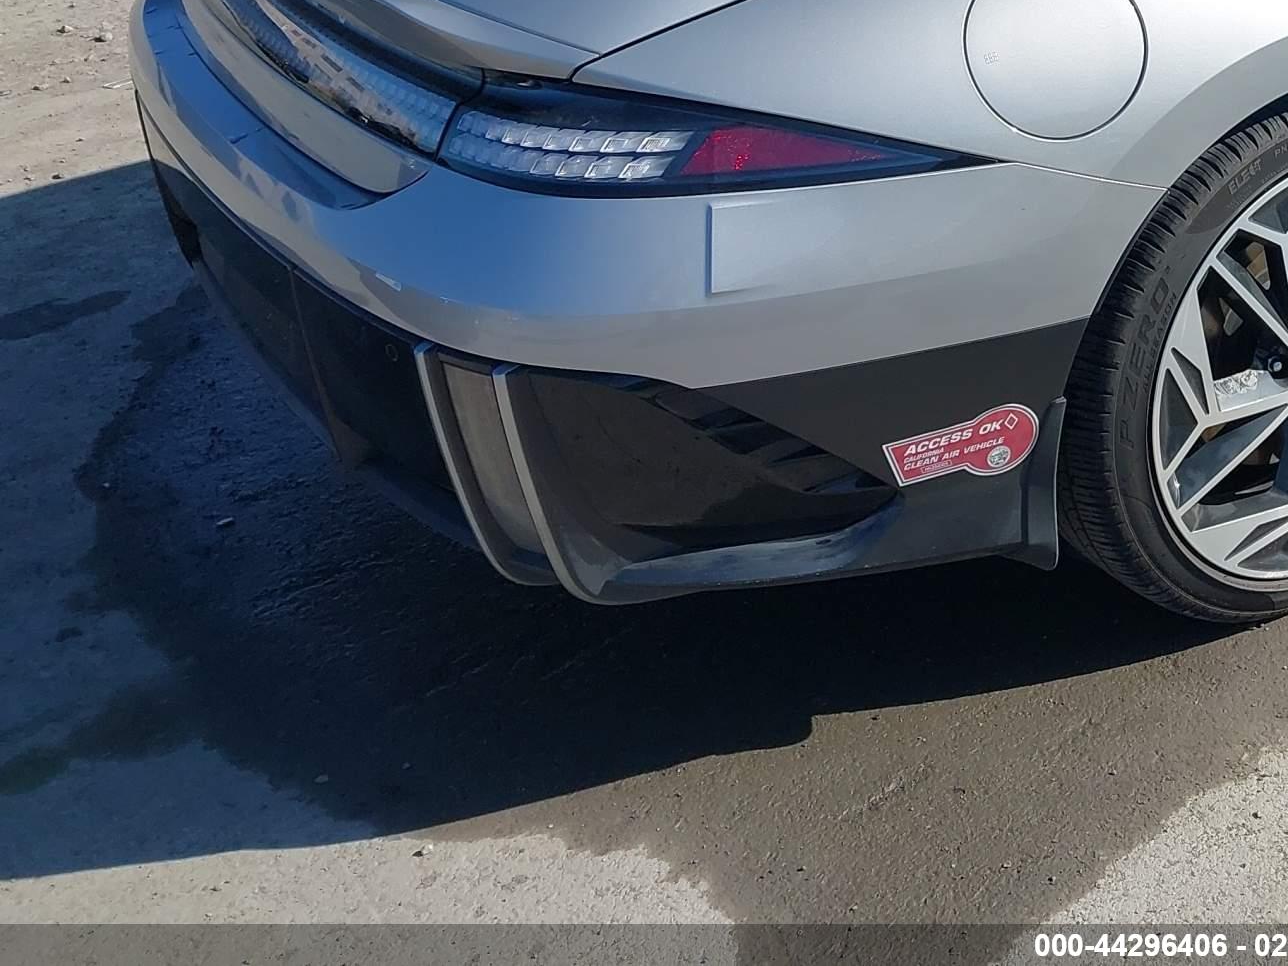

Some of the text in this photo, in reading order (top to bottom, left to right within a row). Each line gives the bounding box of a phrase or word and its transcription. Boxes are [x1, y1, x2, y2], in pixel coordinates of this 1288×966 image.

[1122, 276, 1169, 412] ZERO
[903, 418, 1004, 456] ACCESS OK
[903, 456, 940, 472] CLEAN
[941, 449, 960, 461] AIR
[963, 436, 1005, 454] VEHICLE
[903, 447, 945, 465] CALIFORNIA
